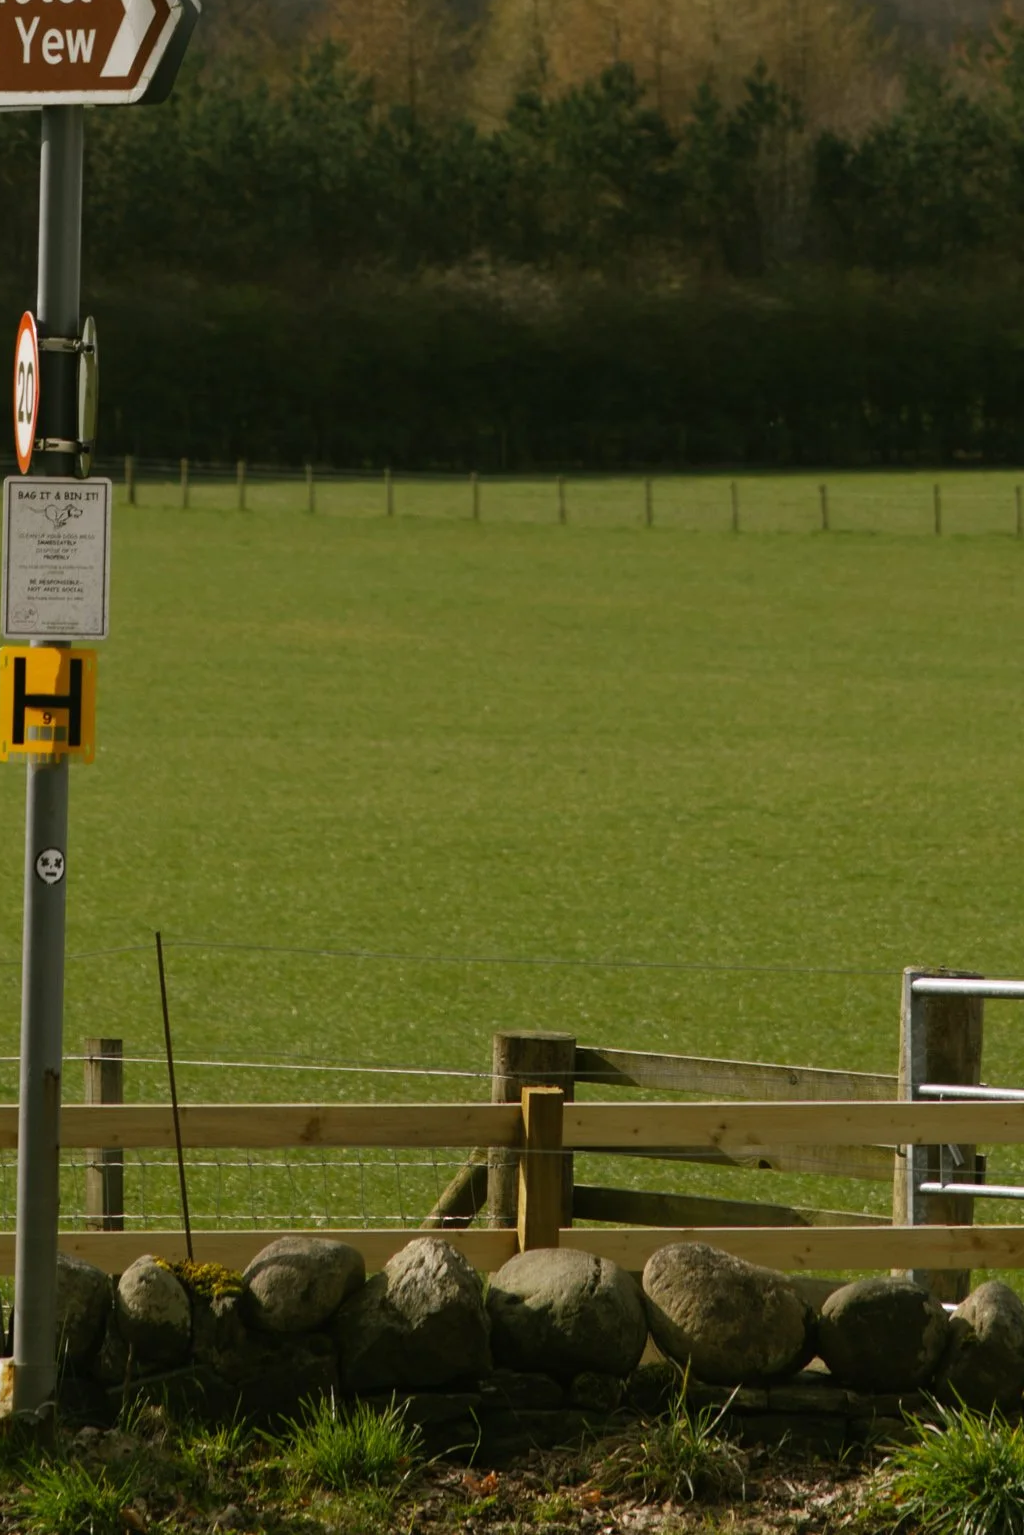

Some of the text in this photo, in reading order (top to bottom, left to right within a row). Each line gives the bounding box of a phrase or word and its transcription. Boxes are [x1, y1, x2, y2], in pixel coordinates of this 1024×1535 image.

[15, 16, 97, 65] Yew
[18, 361, 34, 425] 20
[18, 491, 99, 501] BAG IT & BIN IT!
[12, 657, 83, 746] H
[42, 711, 52, 725] 9
